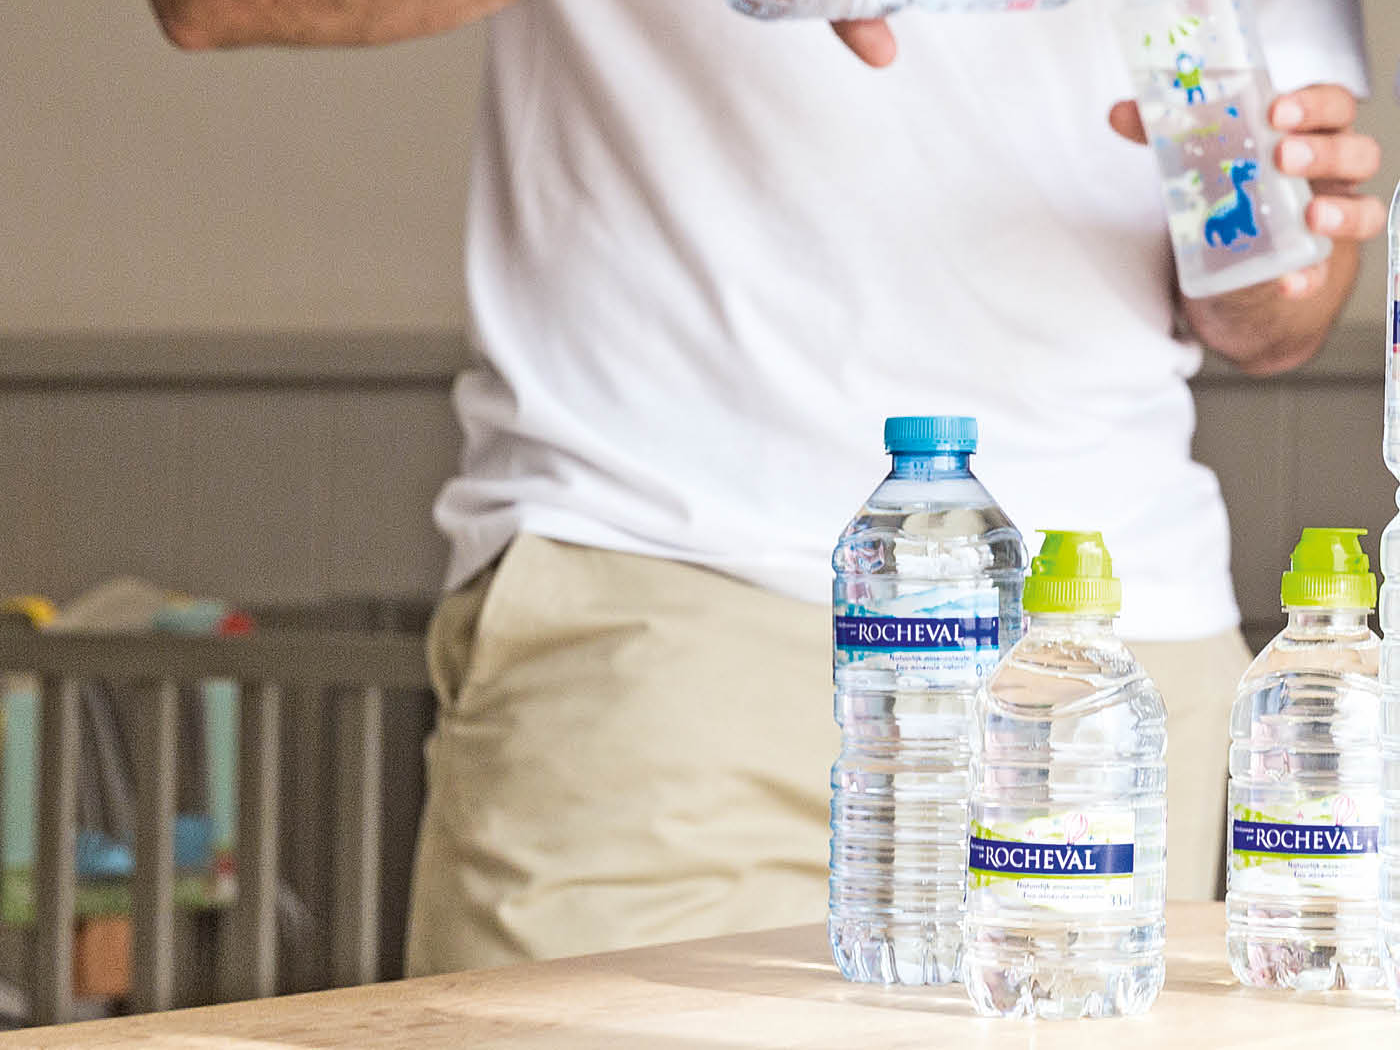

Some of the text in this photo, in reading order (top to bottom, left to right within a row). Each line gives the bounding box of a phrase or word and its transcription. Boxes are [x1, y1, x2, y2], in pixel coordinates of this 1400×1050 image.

[858, 623, 965, 643] ROCHEVAL
[1256, 828, 1363, 850] ROCHEVAL
[985, 845, 1097, 871] ROCHEVAL
